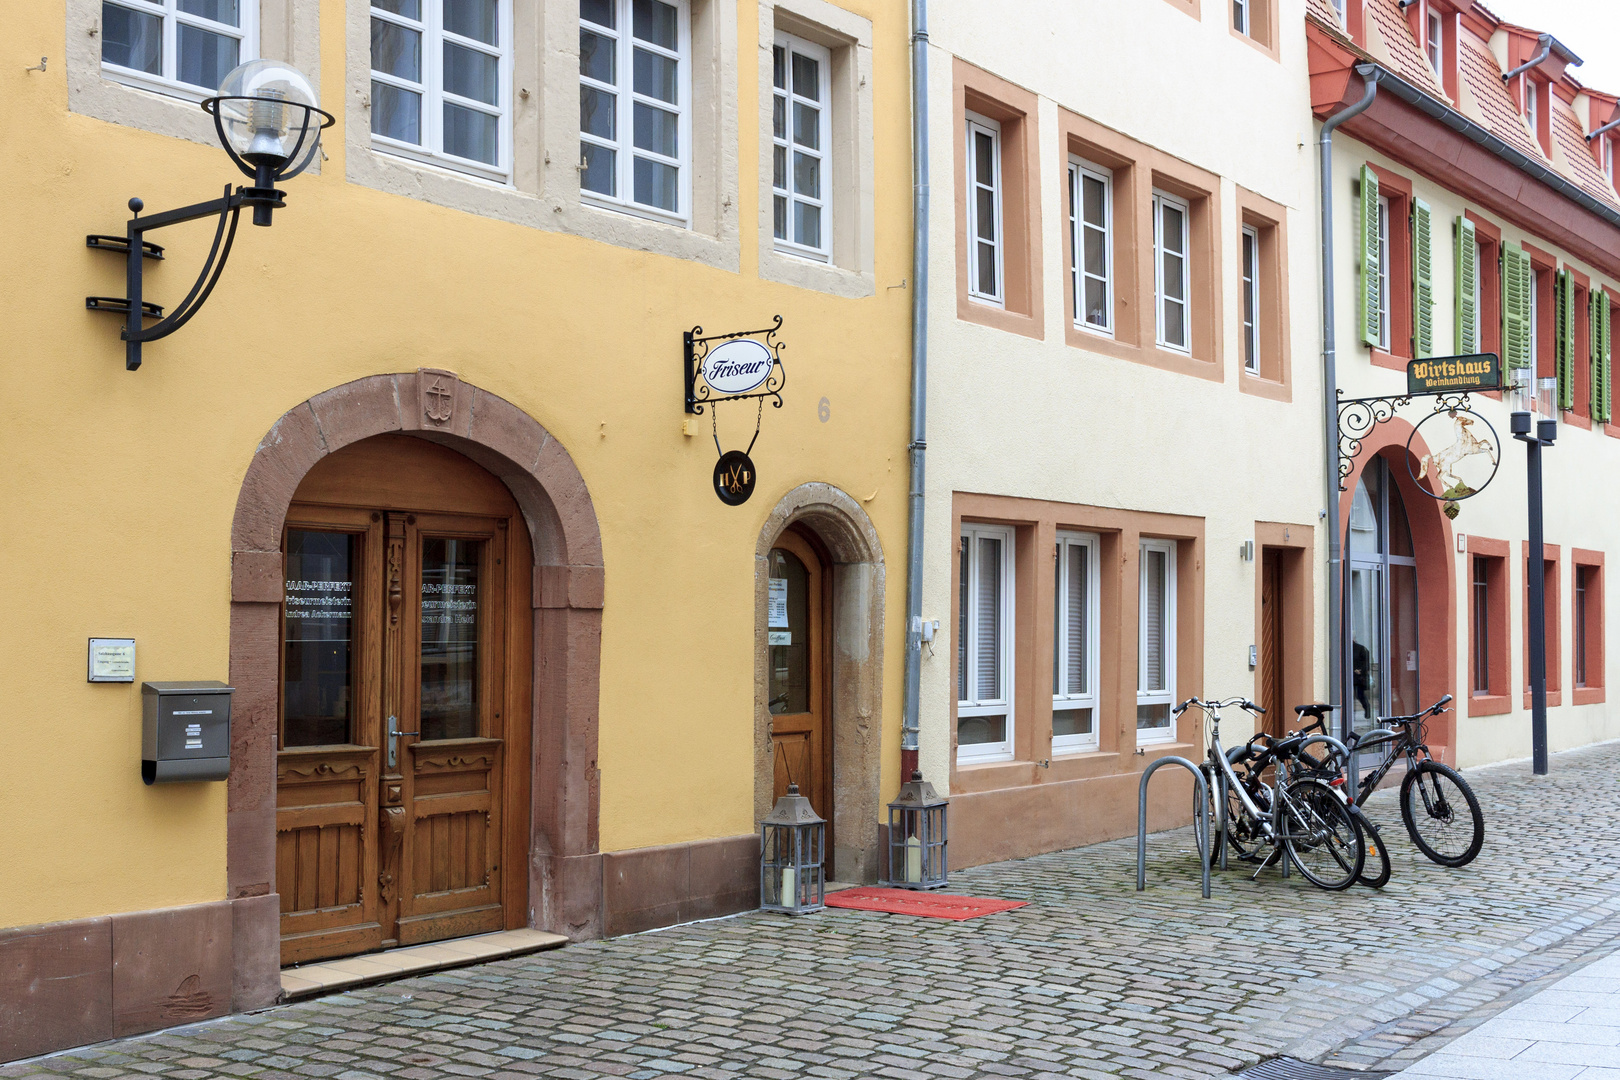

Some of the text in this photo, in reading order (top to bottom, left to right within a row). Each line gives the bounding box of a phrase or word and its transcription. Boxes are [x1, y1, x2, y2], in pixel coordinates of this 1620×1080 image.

[709, 358, 765, 380] Friseur
[1413, 360, 1491, 379] Wirtshaus
[818, 396, 831, 423] 6
[743, 470, 751, 485] P
